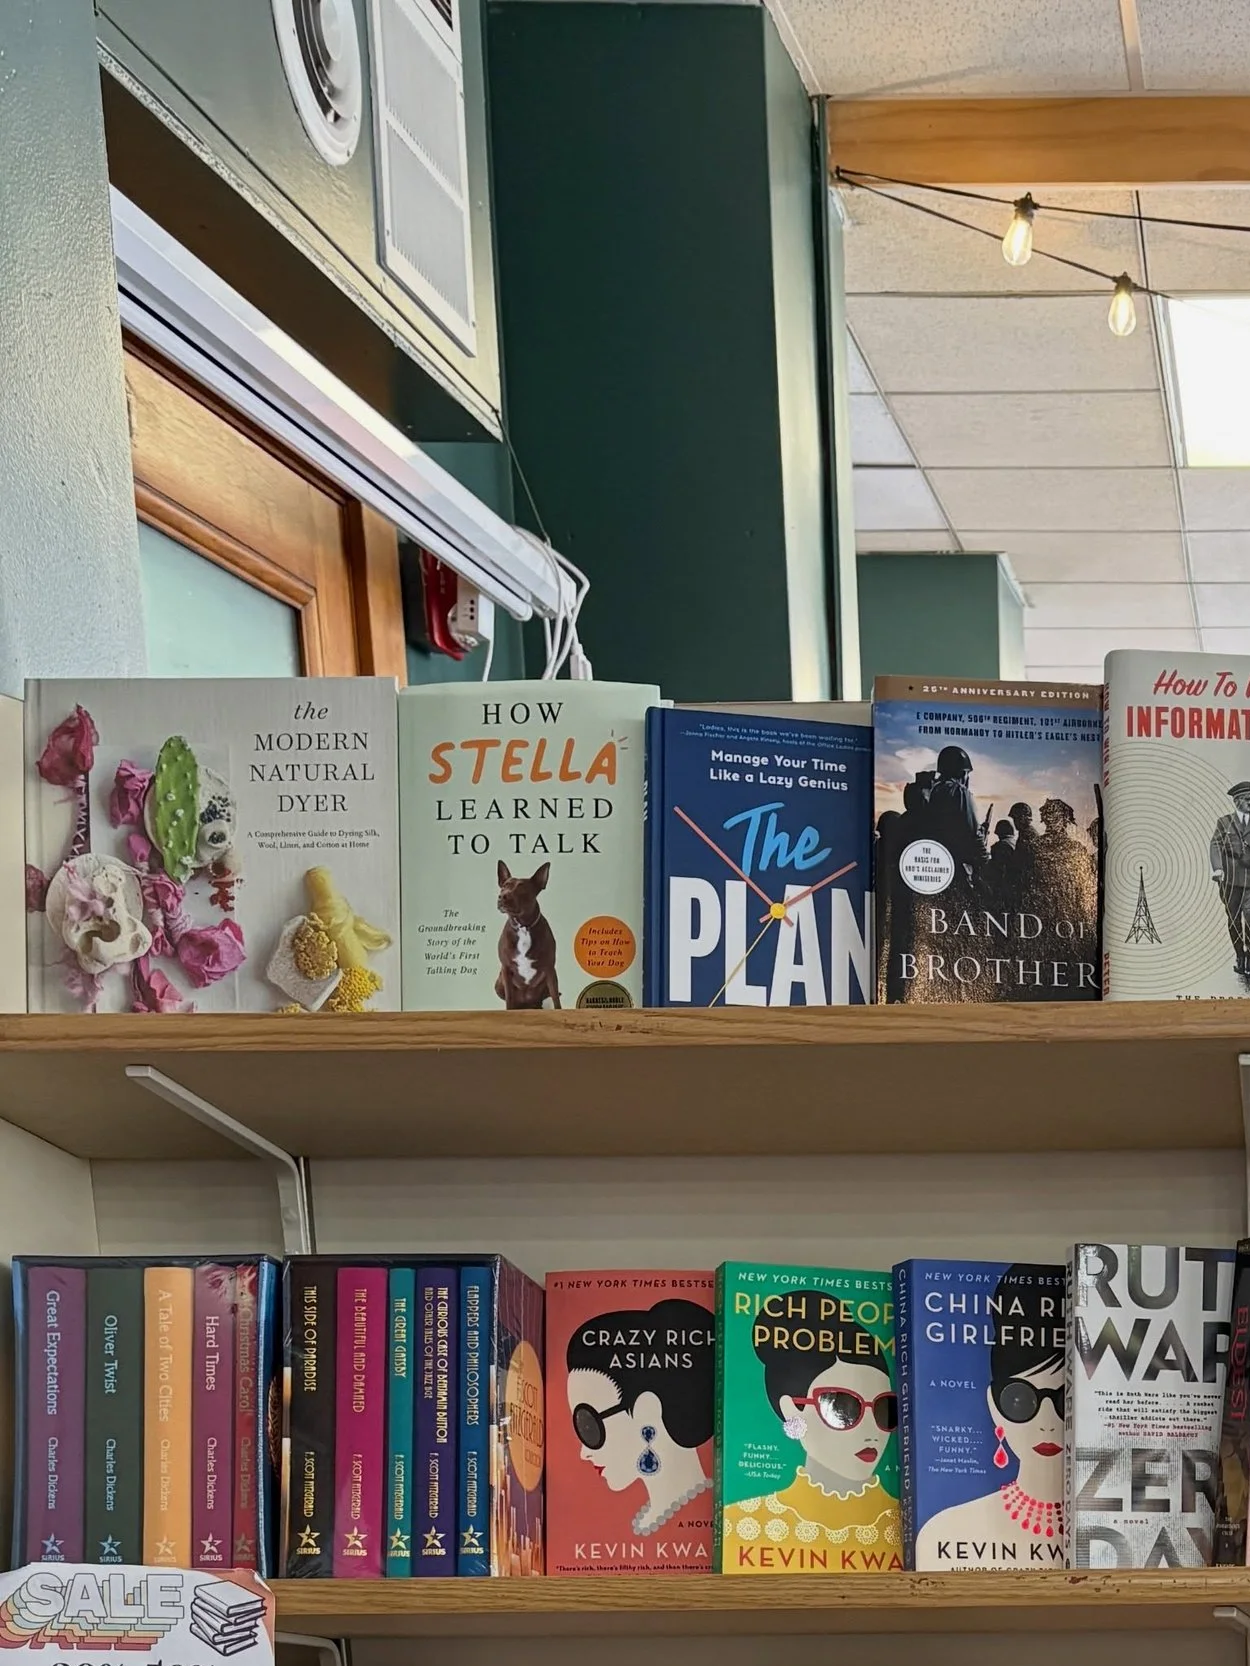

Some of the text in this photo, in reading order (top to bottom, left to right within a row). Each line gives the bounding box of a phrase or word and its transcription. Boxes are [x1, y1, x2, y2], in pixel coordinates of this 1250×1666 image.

[1153, 669, 1207, 695] How
[1213, 672, 1237, 698] To
[294, 702, 328, 719] the
[482, 702, 564, 724] HOW
[254, 732, 368, 751] MODERN
[428, 738, 617, 785] STELLA
[711, 750, 847, 772] Manage Your Time
[250, 763, 375, 782] NATURAL
[710, 769, 848, 791] Like a Lazy Genius
[277, 794, 348, 812] DYER
[436, 798, 613, 820] LEARNED
[448, 833, 601, 854] TO TALK
[723, 802, 832, 877] The
[444, 910, 459, 918] The
[418, 923, 486, 933] Groundbreaking
[424, 952, 480, 960] World's First
[426, 966, 478, 976] Talking Dog
[734, 1292, 814, 1320] RICH
[925, 1292, 1026, 1317] CHINA
[303, 1285, 317, 1392] THIS SIDE OF PARADISE
[582, 1330, 659, 1347] CRAZY
[46, 1290, 60, 1416] Great Expectations
[104, 1315, 118, 1394] Oliver Twist
[206, 1316, 220, 1391] Hard Times
[609, 1352, 694, 1369] ASIANS
[575, 1542, 648, 1559] KEVIN
